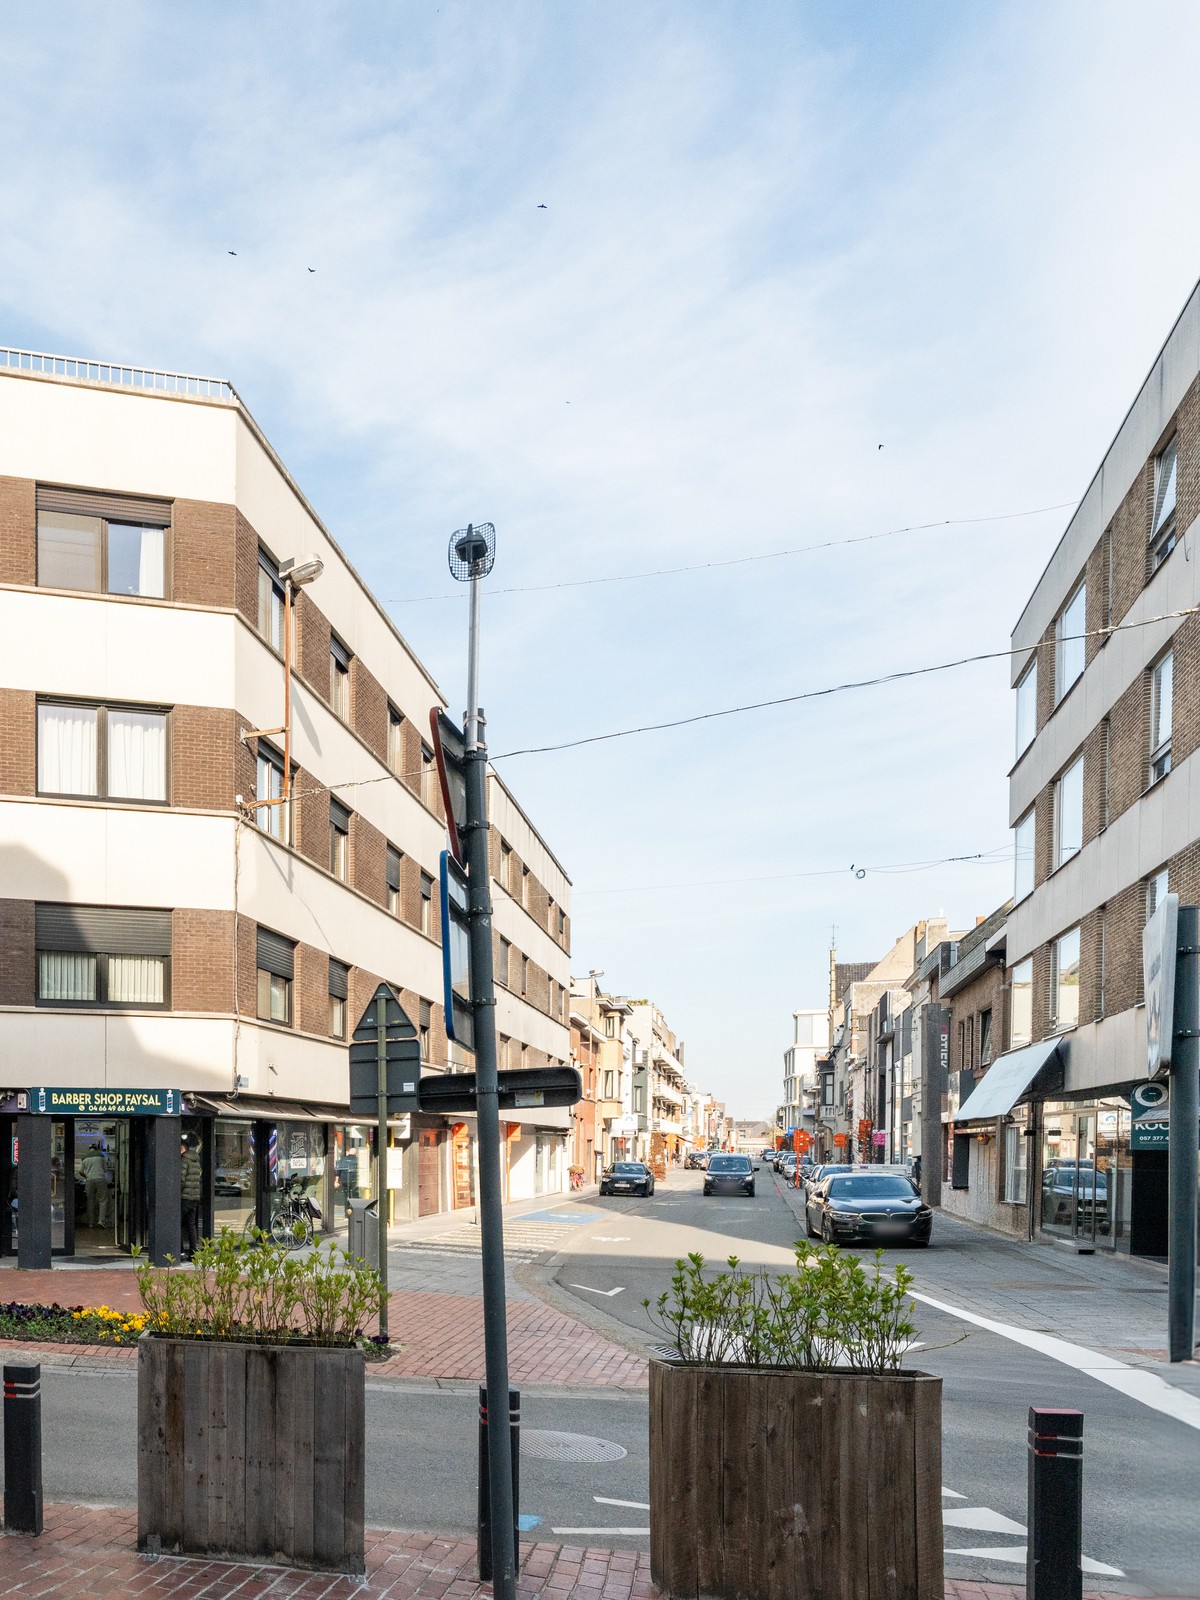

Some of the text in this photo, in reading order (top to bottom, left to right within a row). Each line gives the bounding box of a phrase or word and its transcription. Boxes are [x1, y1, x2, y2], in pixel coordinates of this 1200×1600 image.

[51, 1093, 161, 1106] BARBER SHOP FAYSAL
